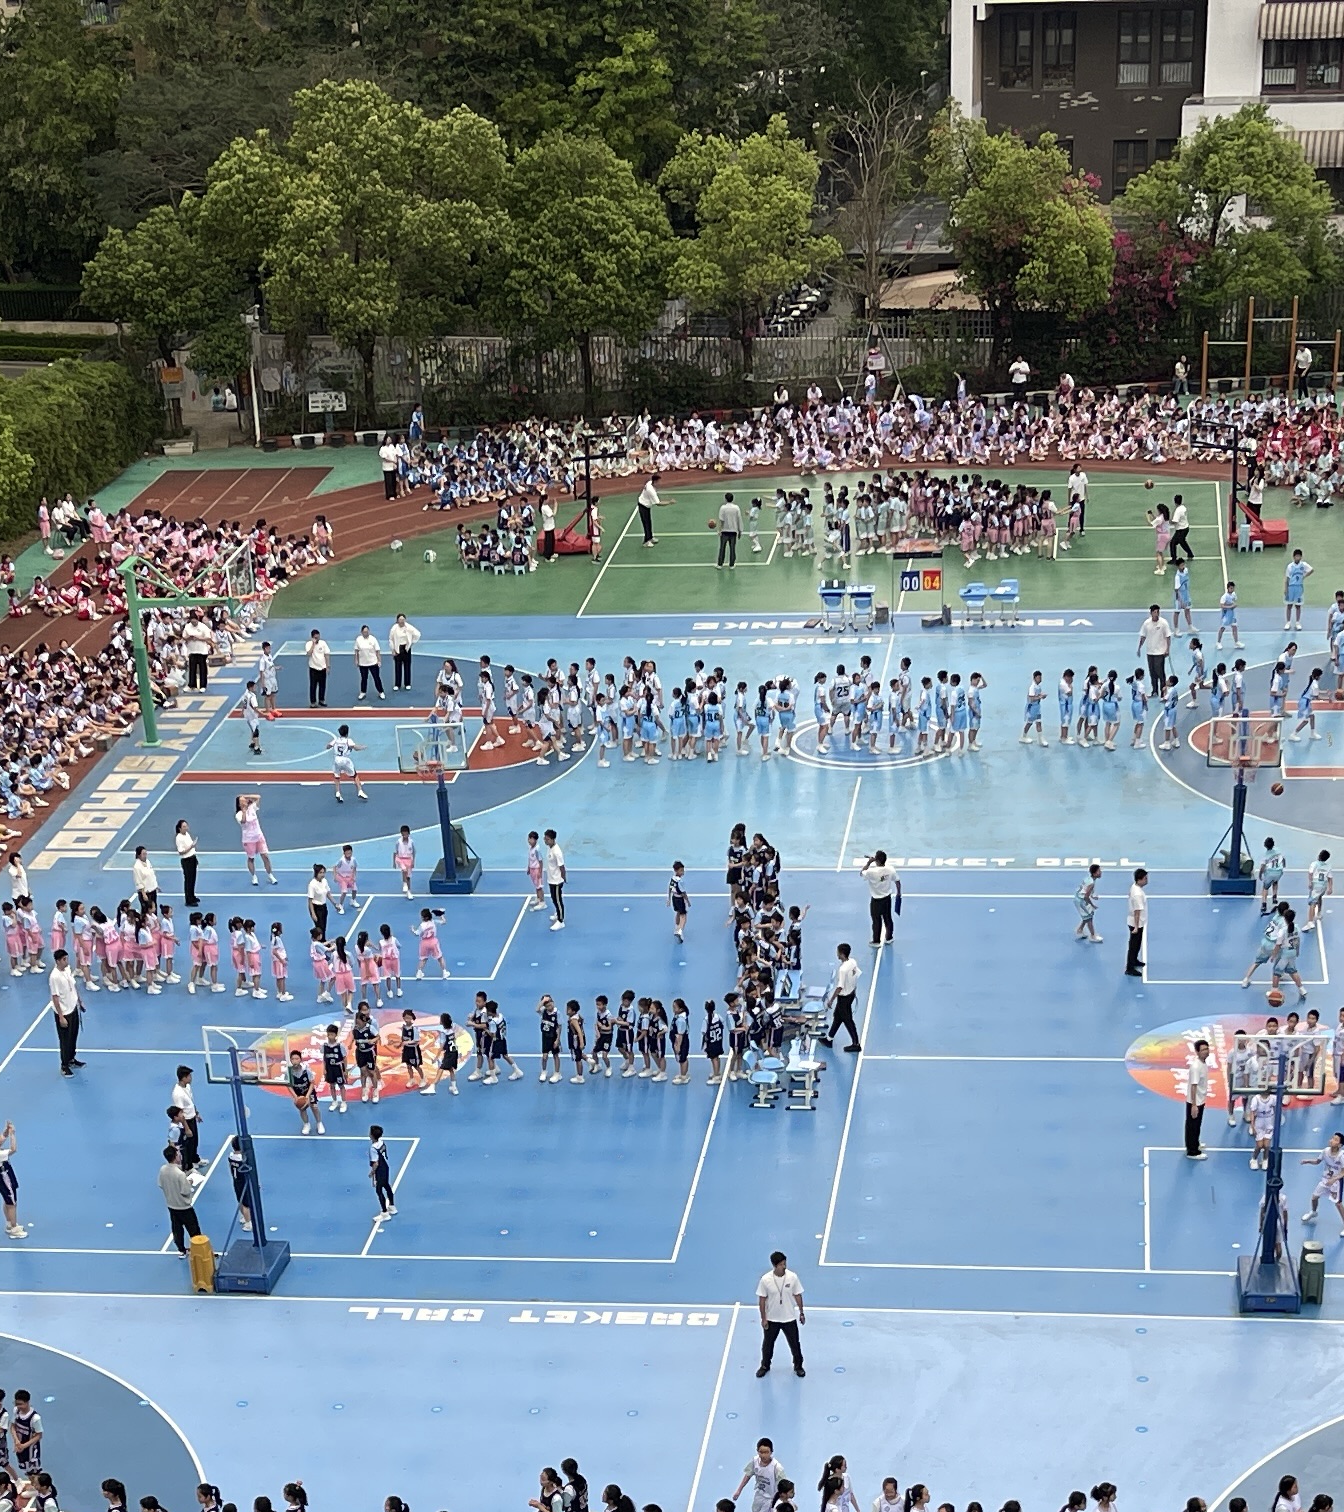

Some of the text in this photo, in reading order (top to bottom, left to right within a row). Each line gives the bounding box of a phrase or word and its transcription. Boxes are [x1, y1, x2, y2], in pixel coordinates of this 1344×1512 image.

[902, 576, 919, 591] 00
[924, 575, 941, 590] 04
[509, 1309, 719, 1326] BASKET
